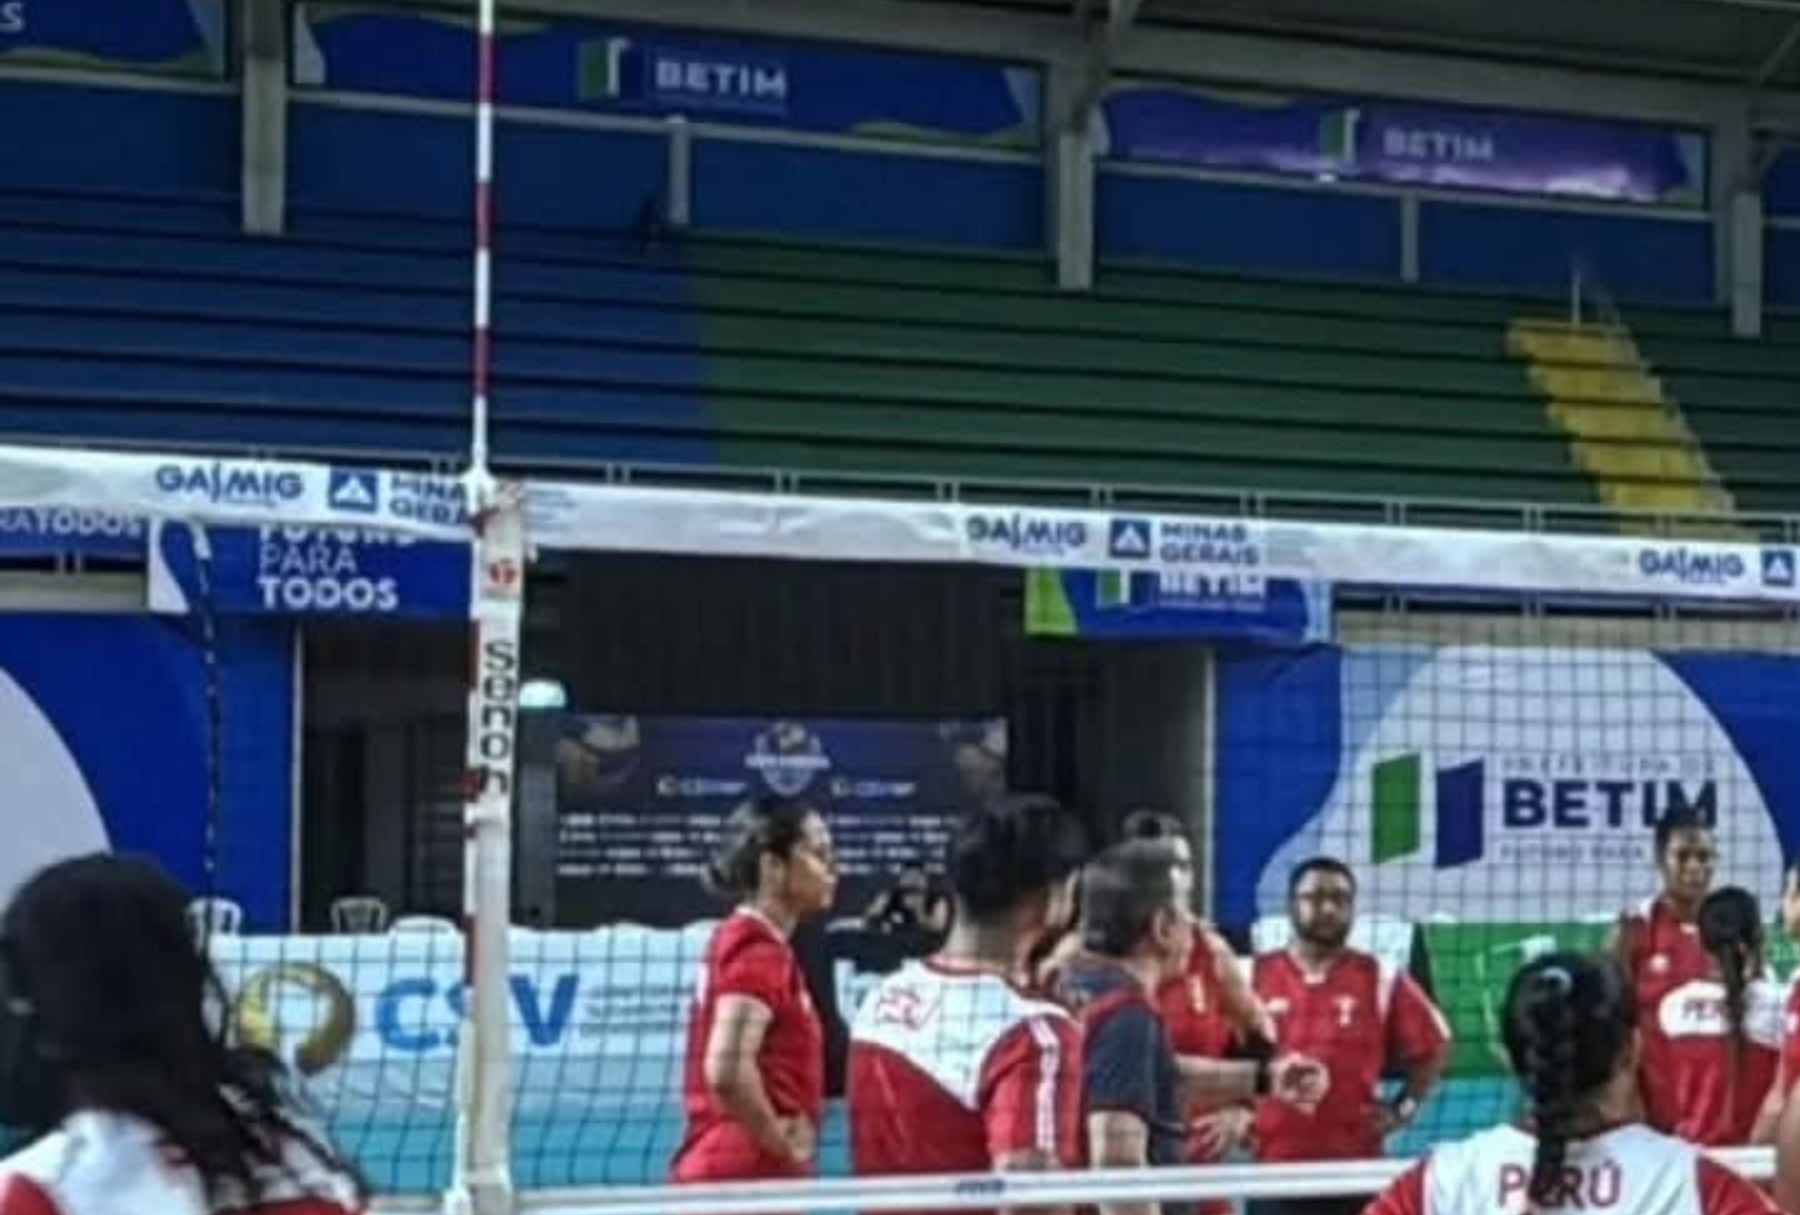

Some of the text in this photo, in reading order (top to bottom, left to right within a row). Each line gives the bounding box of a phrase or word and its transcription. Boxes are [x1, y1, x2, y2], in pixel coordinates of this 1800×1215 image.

[655, 60, 787, 97] BETIM
[1383, 129, 1494, 162] BETIM
[390, 473, 466, 498] MINA
[39, 507, 142, 538] TODOS
[259, 543, 358, 577] PARA
[258, 576, 398, 611] TODOS
[1503, 779, 1718, 829] BETIM
